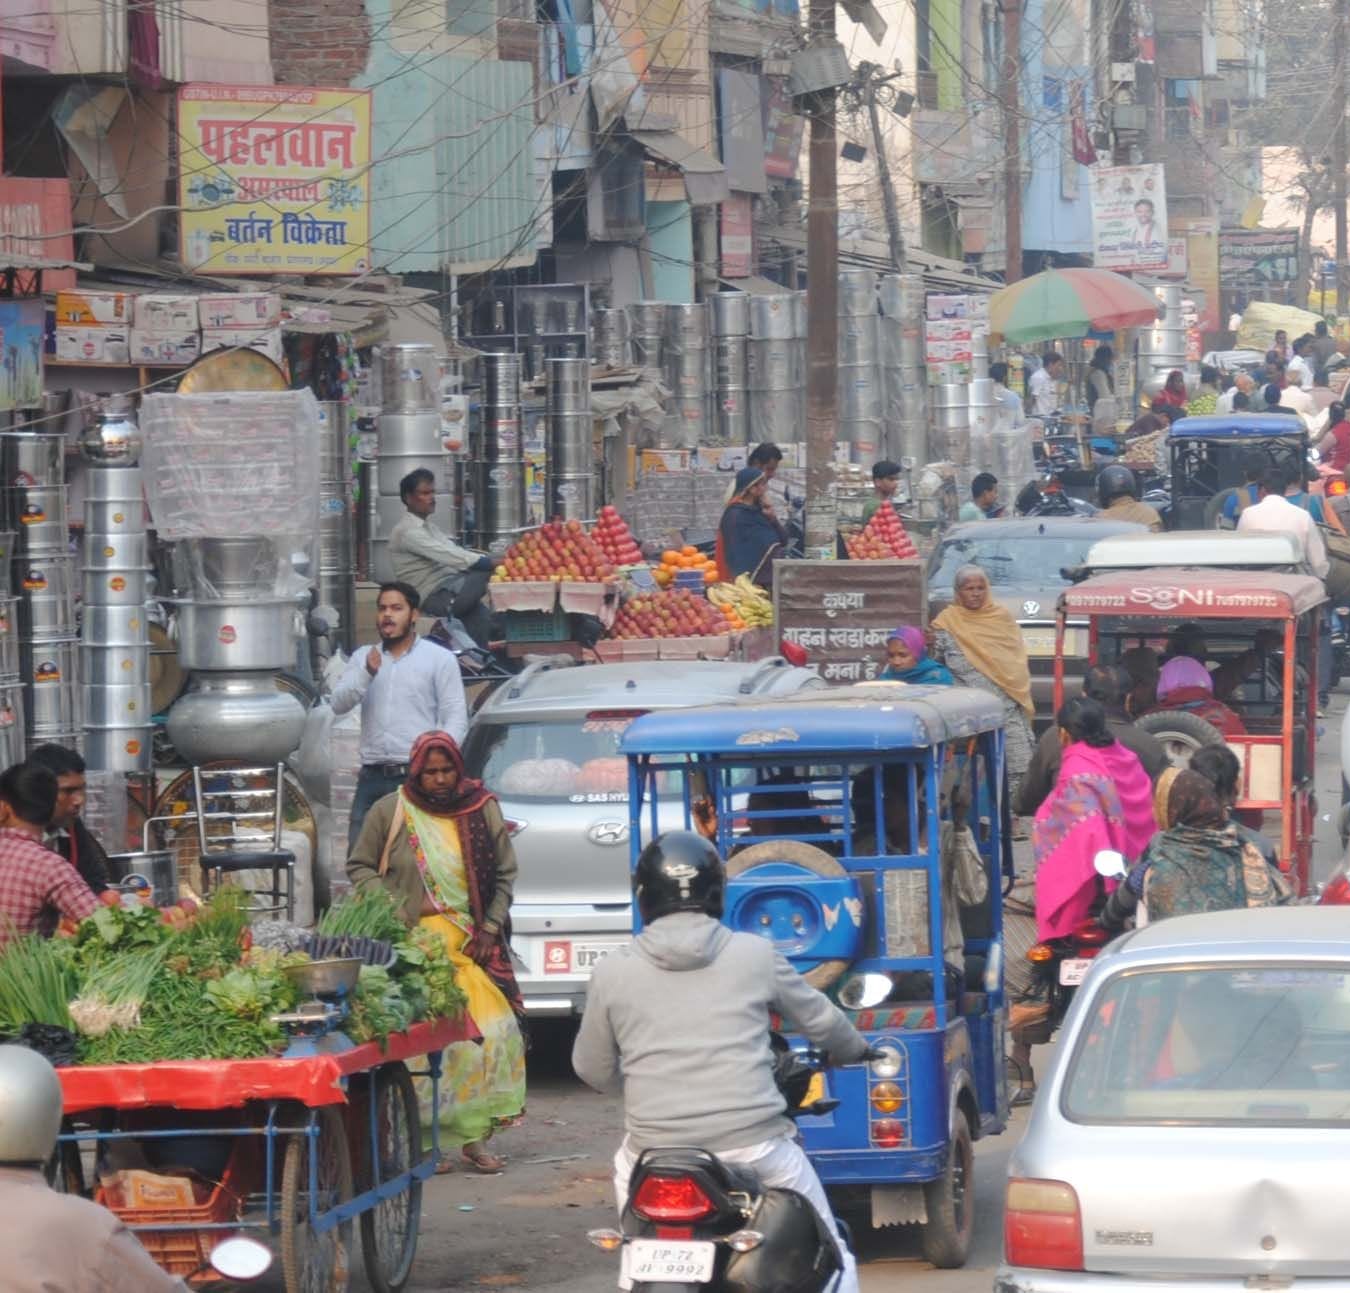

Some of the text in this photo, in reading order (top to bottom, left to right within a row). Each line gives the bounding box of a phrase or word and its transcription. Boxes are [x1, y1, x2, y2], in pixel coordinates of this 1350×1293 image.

[197, 119, 357, 169] पहलवान
[225, 211, 348, 246] बर्तन विक्रेता
[824, 662, 861, 680] मना
